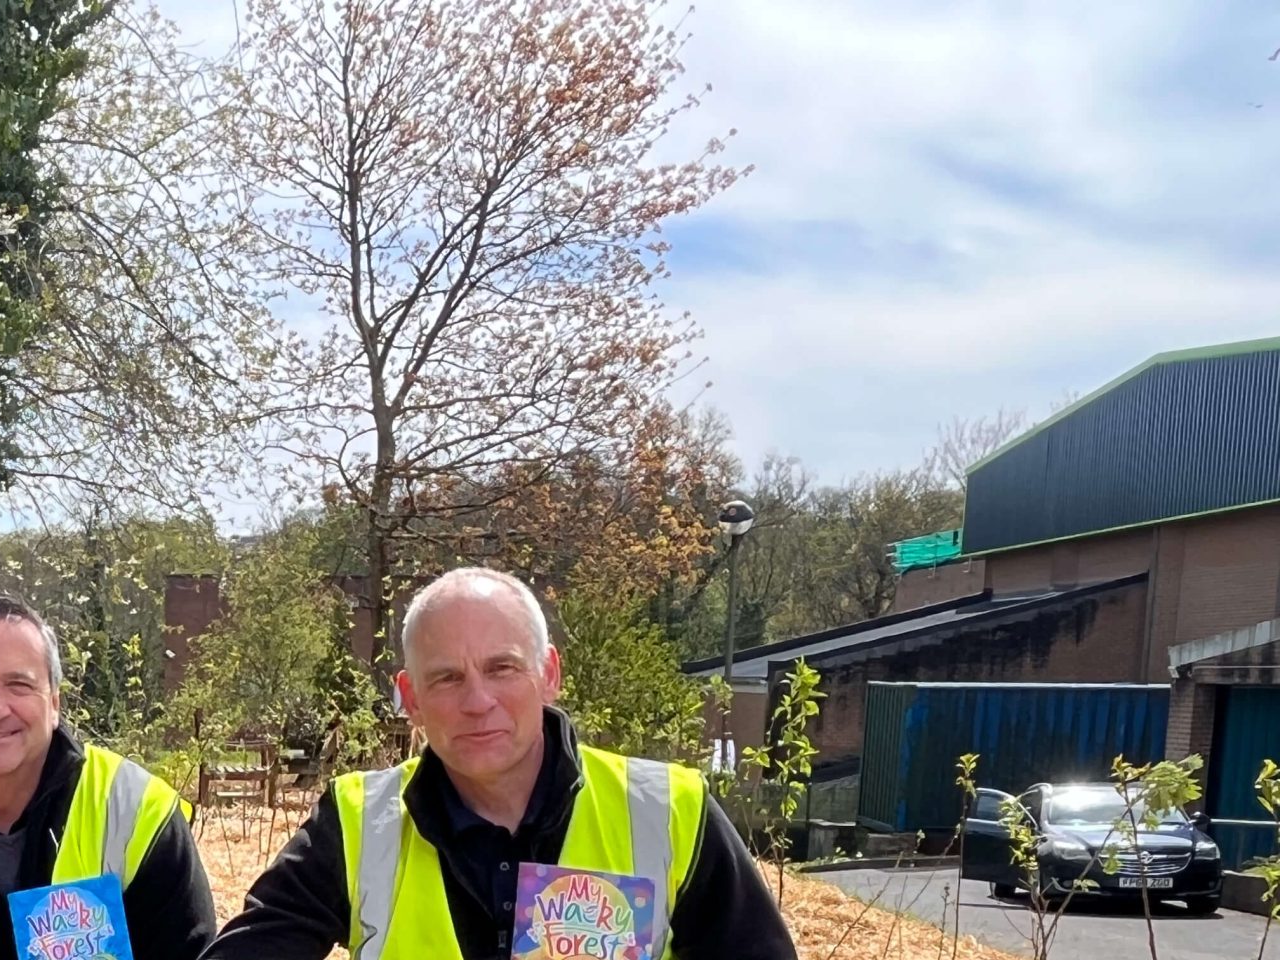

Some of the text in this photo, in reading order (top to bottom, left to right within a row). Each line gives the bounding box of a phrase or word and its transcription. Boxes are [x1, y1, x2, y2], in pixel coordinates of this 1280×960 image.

[51, 890, 78, 914] My
[568, 876, 602, 902] My
[27, 905, 106, 935] Wacky
[536, 893, 632, 934] Wacky
[40, 931, 106, 960] Forest
